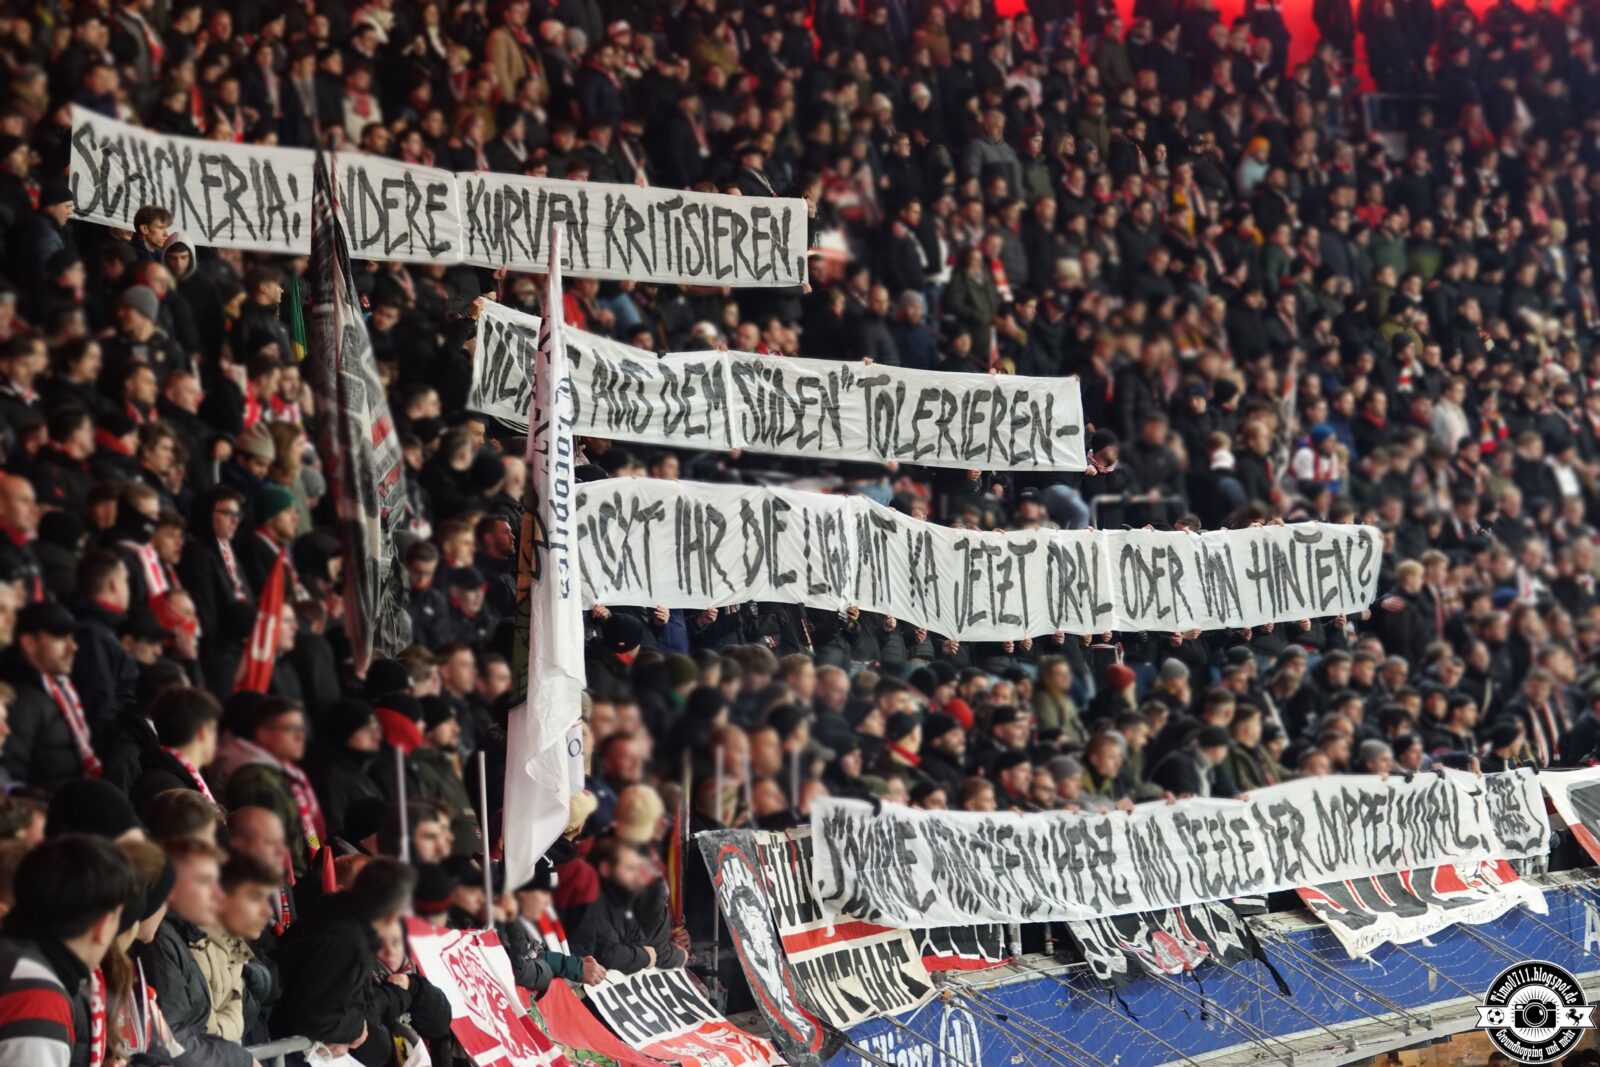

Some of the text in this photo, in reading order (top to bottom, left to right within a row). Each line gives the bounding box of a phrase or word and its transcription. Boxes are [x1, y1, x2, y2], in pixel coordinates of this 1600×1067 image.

[340, 165, 451, 258] NDERE
[466, 177, 590, 270] KURVEN
[605, 193, 804, 283] KRITISIEREN,
[658, 359, 733, 448] DEM
[675, 494, 736, 598] IHR
[740, 495, 798, 588] DIE
[855, 508, 898, 606] MIT
[953, 538, 1038, 633] JETZT
[1046, 538, 1113, 628] ORAL
[1120, 543, 1194, 623] ODER
[1195, 541, 1243, 623] VON
[1246, 529, 1379, 617] HINTEN?
[1250, 798, 1322, 886] DER
[597, 970, 721, 1044] HESSEN
